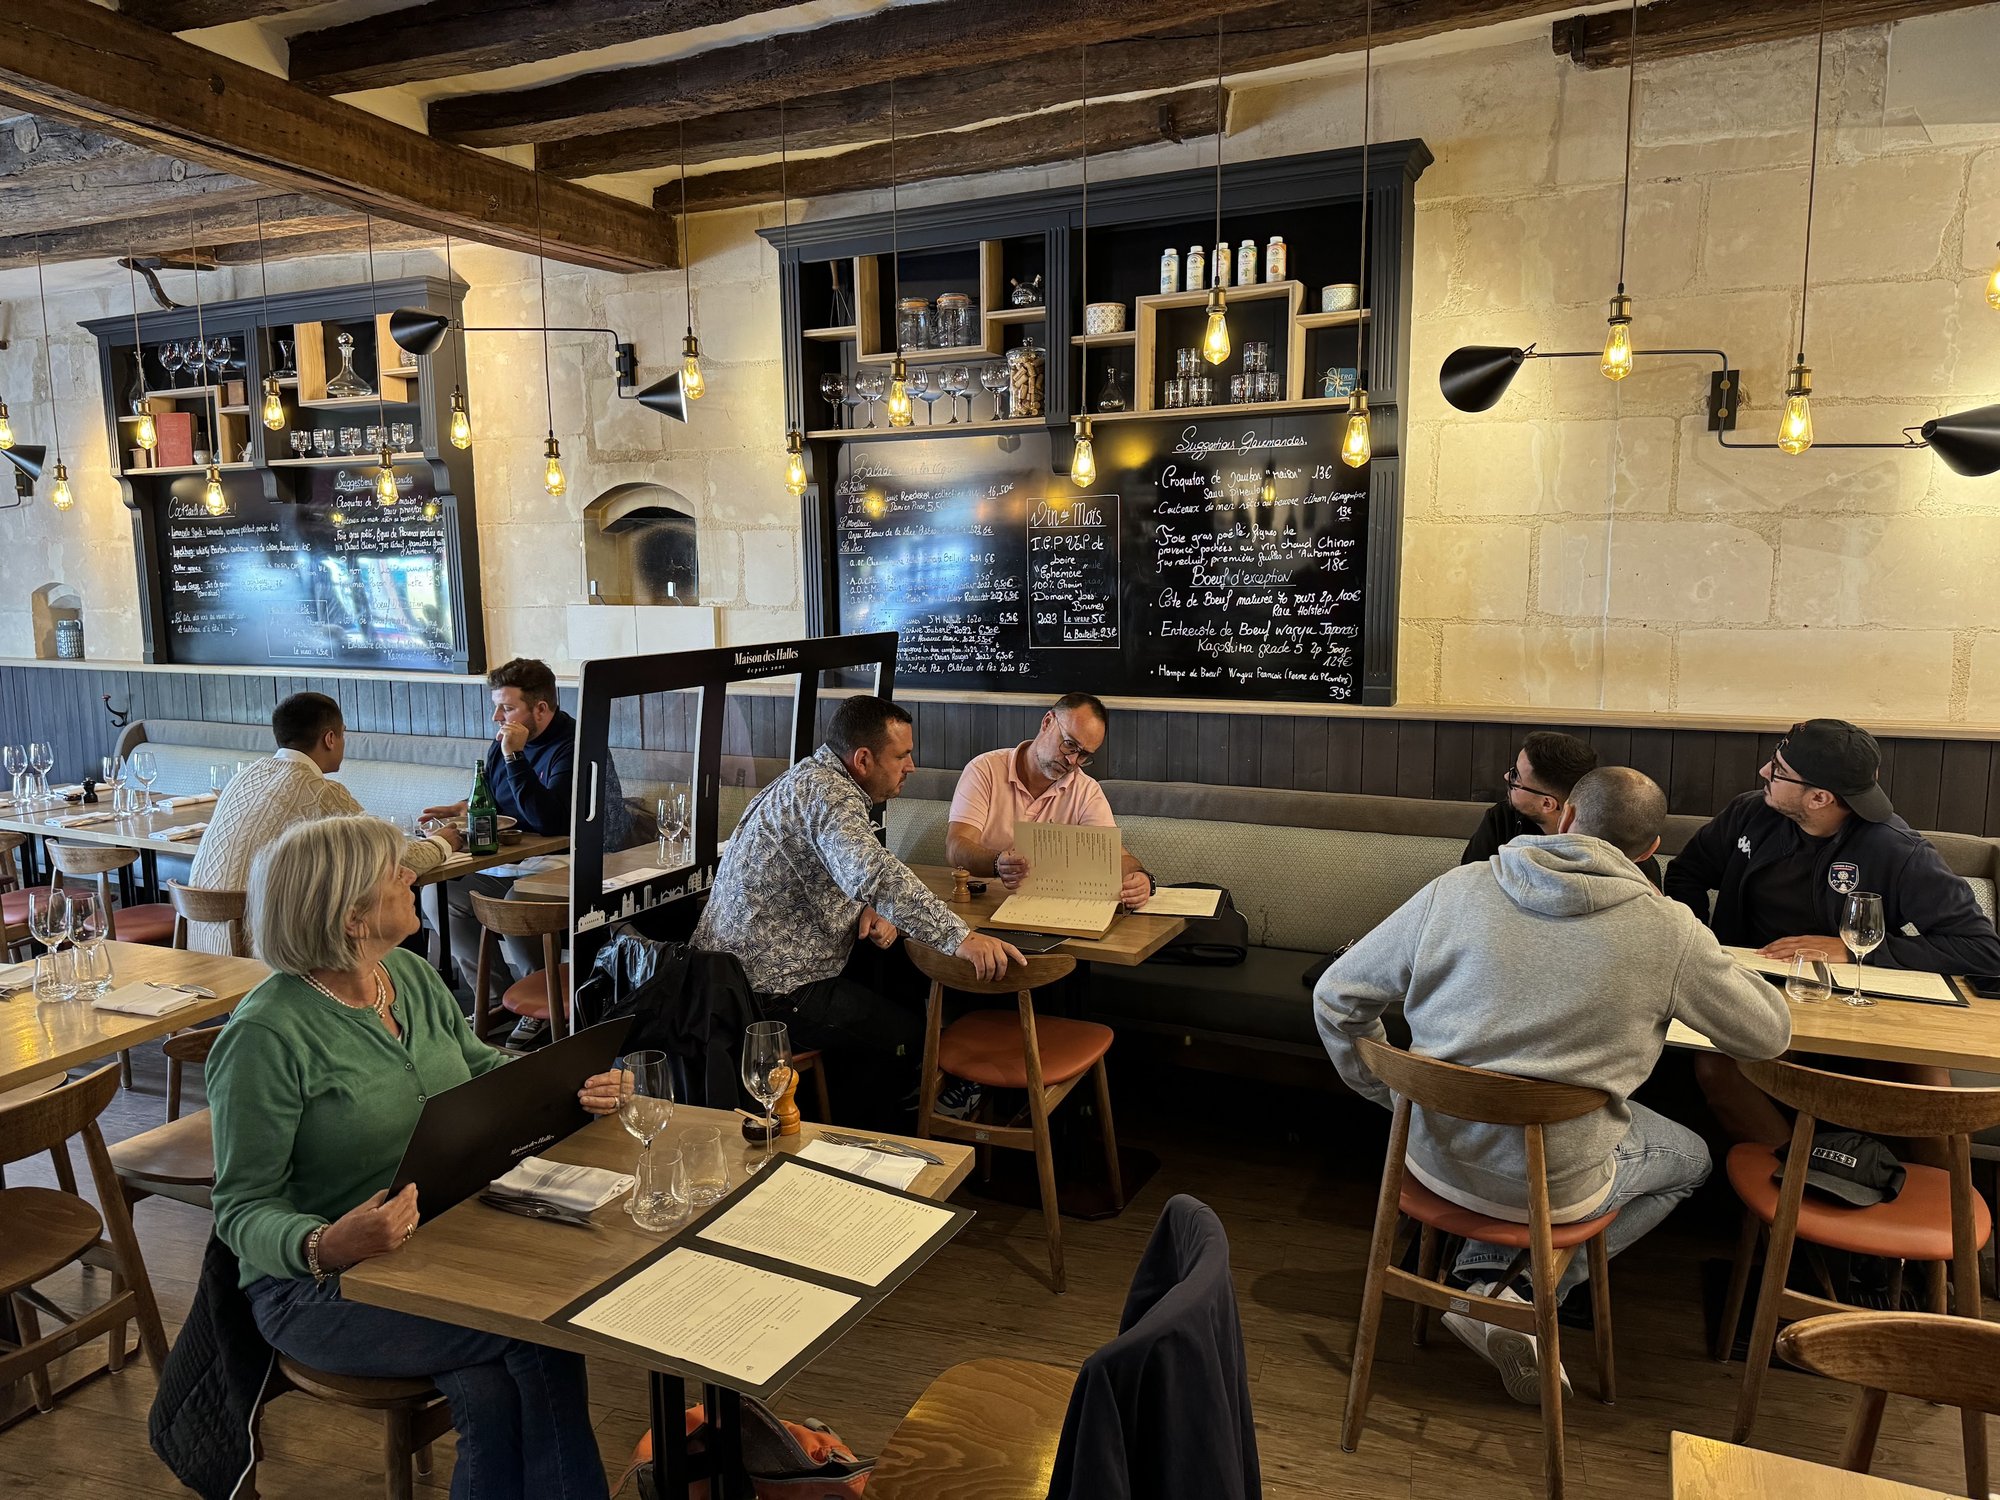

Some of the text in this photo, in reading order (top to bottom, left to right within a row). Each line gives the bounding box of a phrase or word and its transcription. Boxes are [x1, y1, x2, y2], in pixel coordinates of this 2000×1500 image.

[1210, 469, 1222, 485] de
[1311, 465, 1333, 480] 13€
[1204, 501, 1215, 513] de
[1091, 534, 1105, 550] de
[1191, 532, 1213, 550] gras
[1283, 525, 1297, 536] de
[1157, 546, 1194, 561] provence
[1280, 537, 1312, 549] chaud
[1317, 536, 1355, 549] Chinon
[1320, 556, 1350, 572] 18€
[1030, 591, 1074, 602] Domaine
[1158, 587, 1182, 608] Côte
[1186, 592, 1199, 608] de
[1335, 588, 1362, 602] 100€
[1219, 620, 1234, 637] de
[734, 647, 799, 666] Maison des Halles
[1293, 643, 1303, 655] 5
[976, 662, 985, 672] de
[1189, 668, 1198, 678] de
[1328, 686, 1352, 700] 39€
